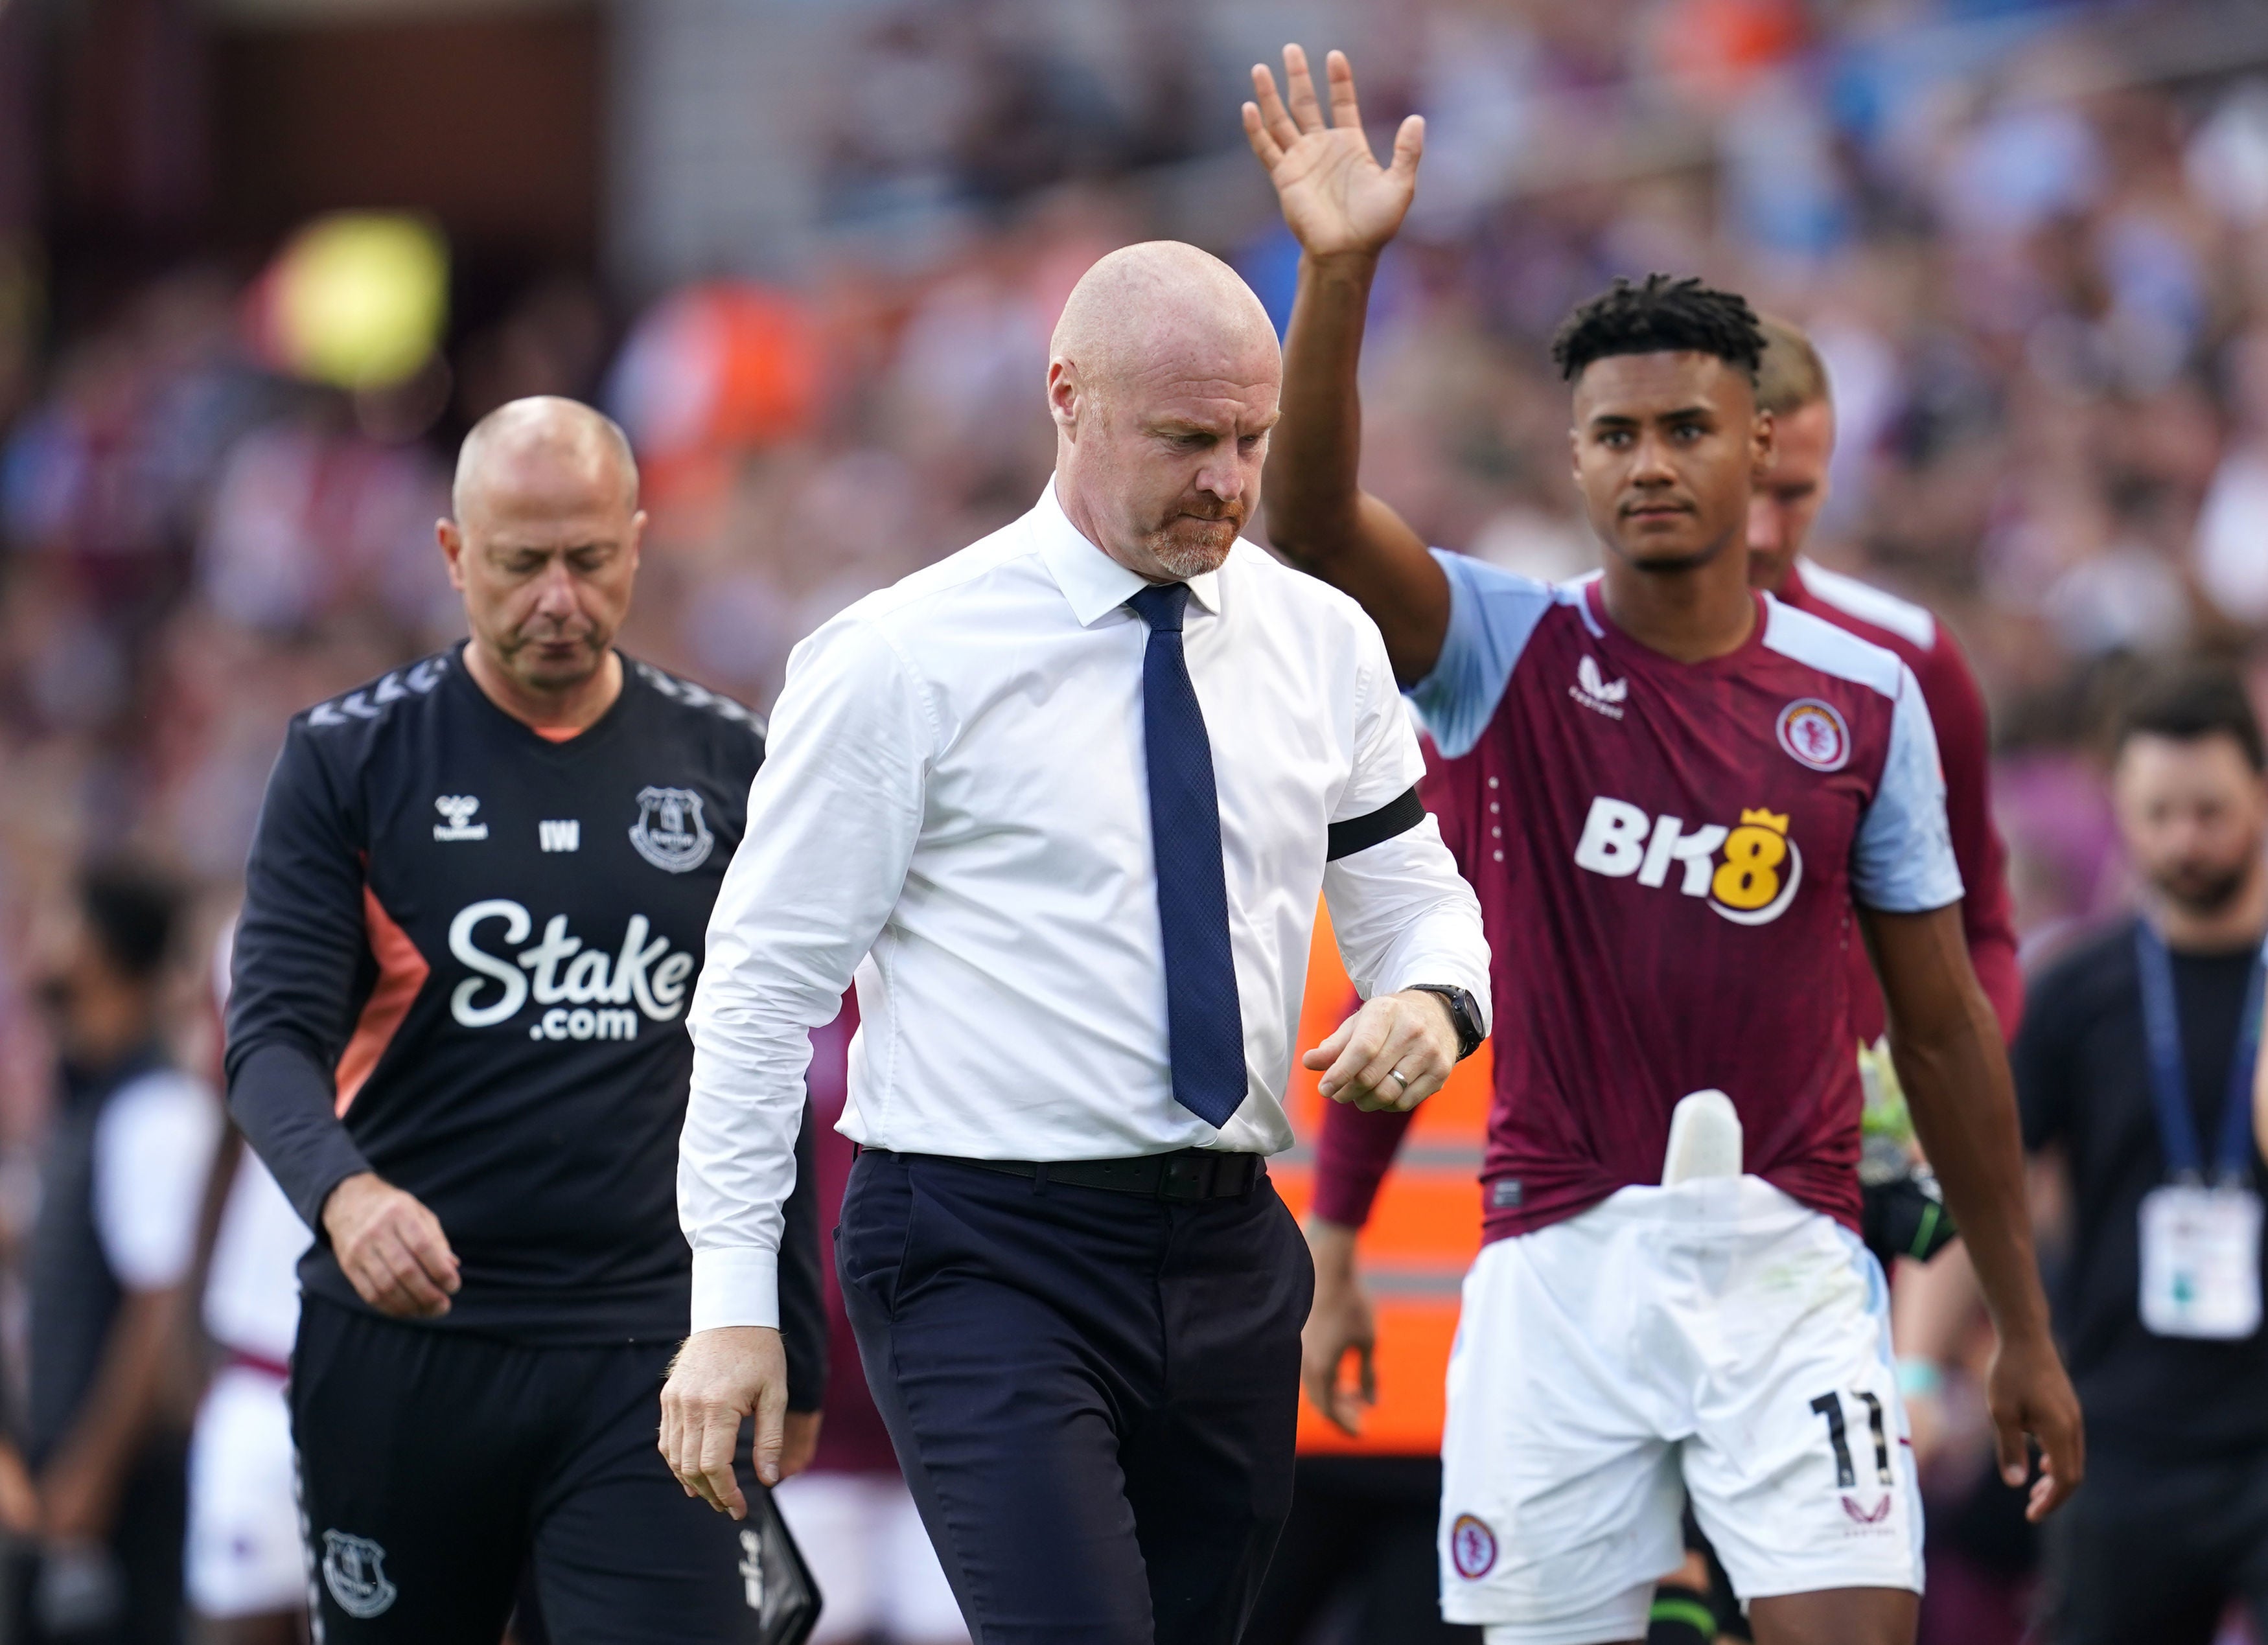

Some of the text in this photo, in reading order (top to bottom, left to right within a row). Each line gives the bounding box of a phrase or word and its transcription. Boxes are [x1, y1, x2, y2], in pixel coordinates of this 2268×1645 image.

[1574, 796, 1788, 910] BK8
[448, 899, 694, 1028] Stake
[529, 1008, 638, 1041] .com
[1810, 1390, 1893, 1488] 11
